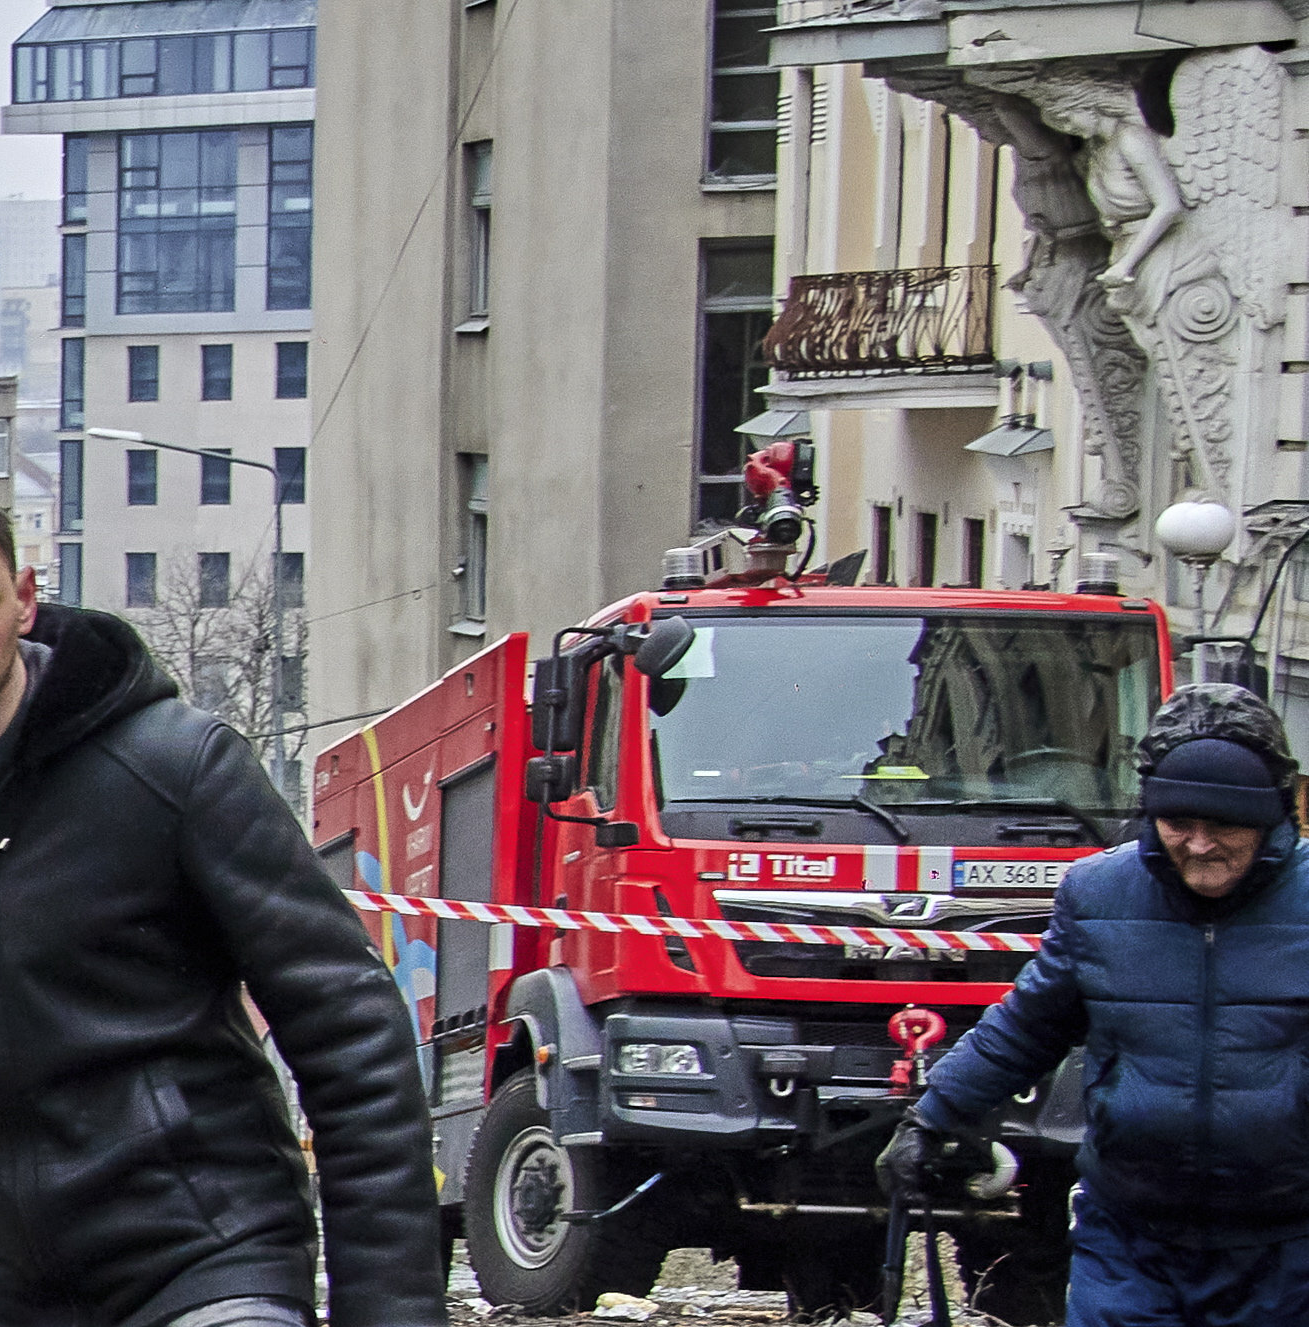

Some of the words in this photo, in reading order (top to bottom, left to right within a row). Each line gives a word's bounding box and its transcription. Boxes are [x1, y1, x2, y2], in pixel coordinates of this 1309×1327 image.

[766, 853, 837, 877] Tital
[969, 865, 997, 884] AX
[1003, 865, 1038, 884] 368
